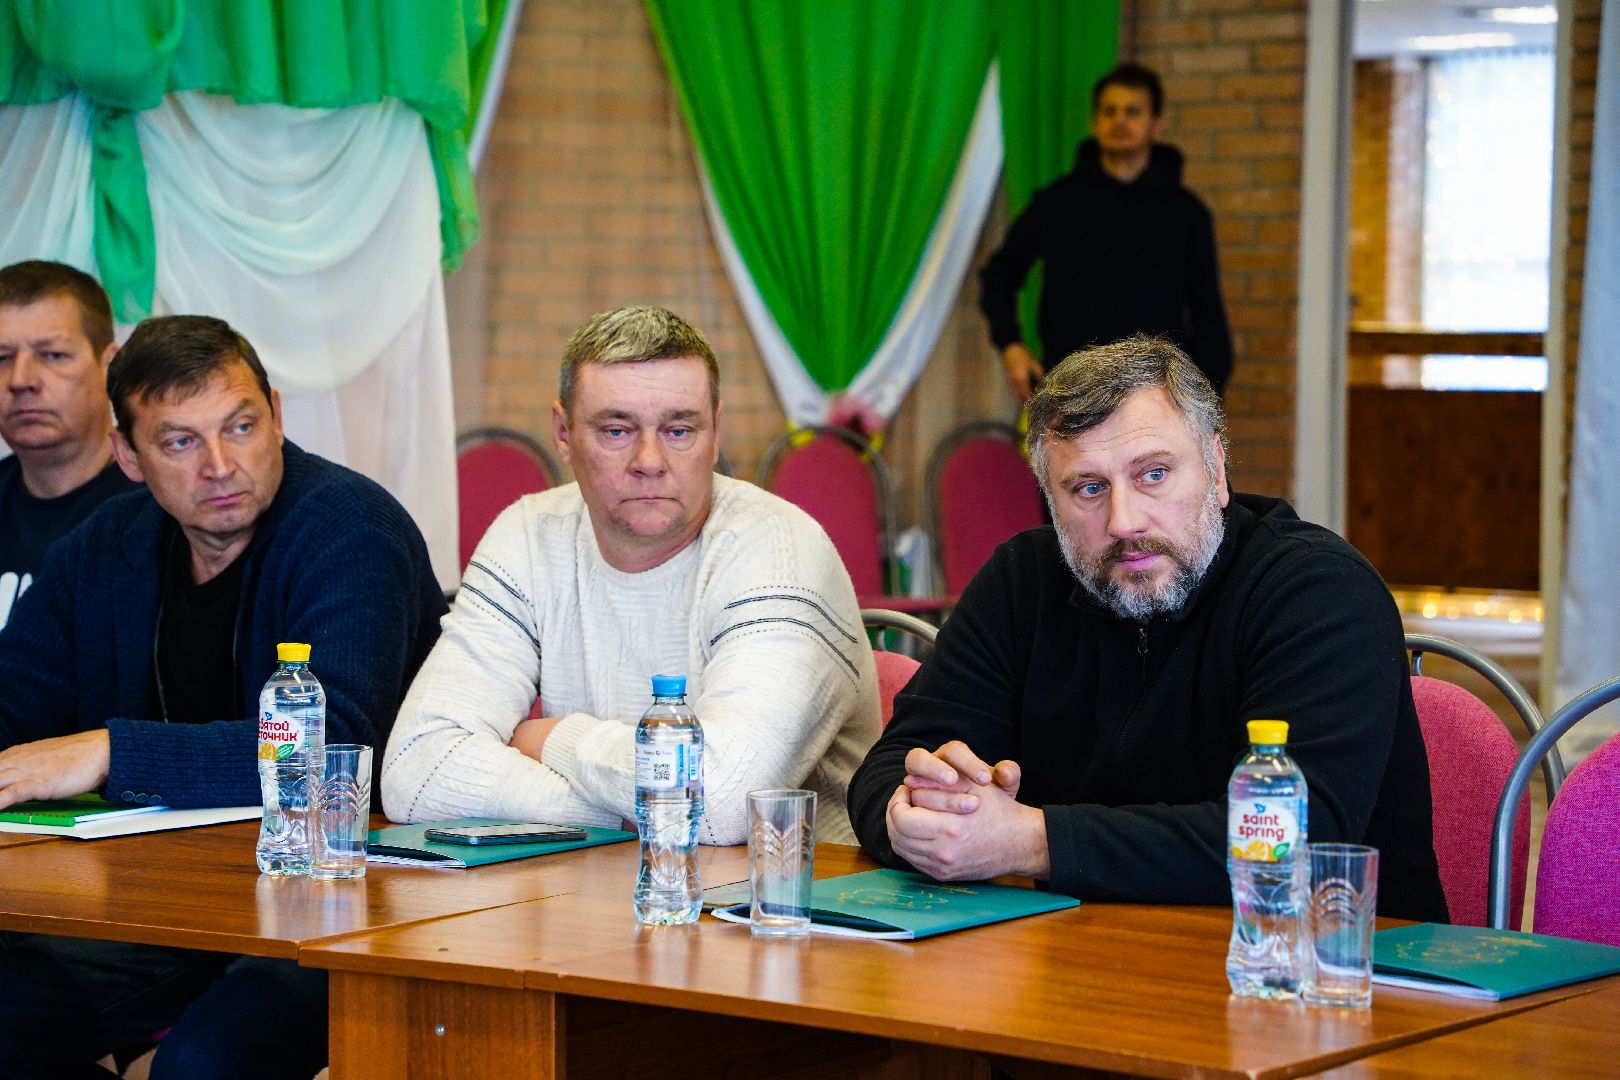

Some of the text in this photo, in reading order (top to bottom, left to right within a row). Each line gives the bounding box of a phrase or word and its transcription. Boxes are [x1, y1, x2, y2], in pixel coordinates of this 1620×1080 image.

[258, 717, 289, 732] вятой
[258, 731, 298, 742] точник
[1243, 814, 1280, 826] saint
[1239, 825, 1285, 842] spring
